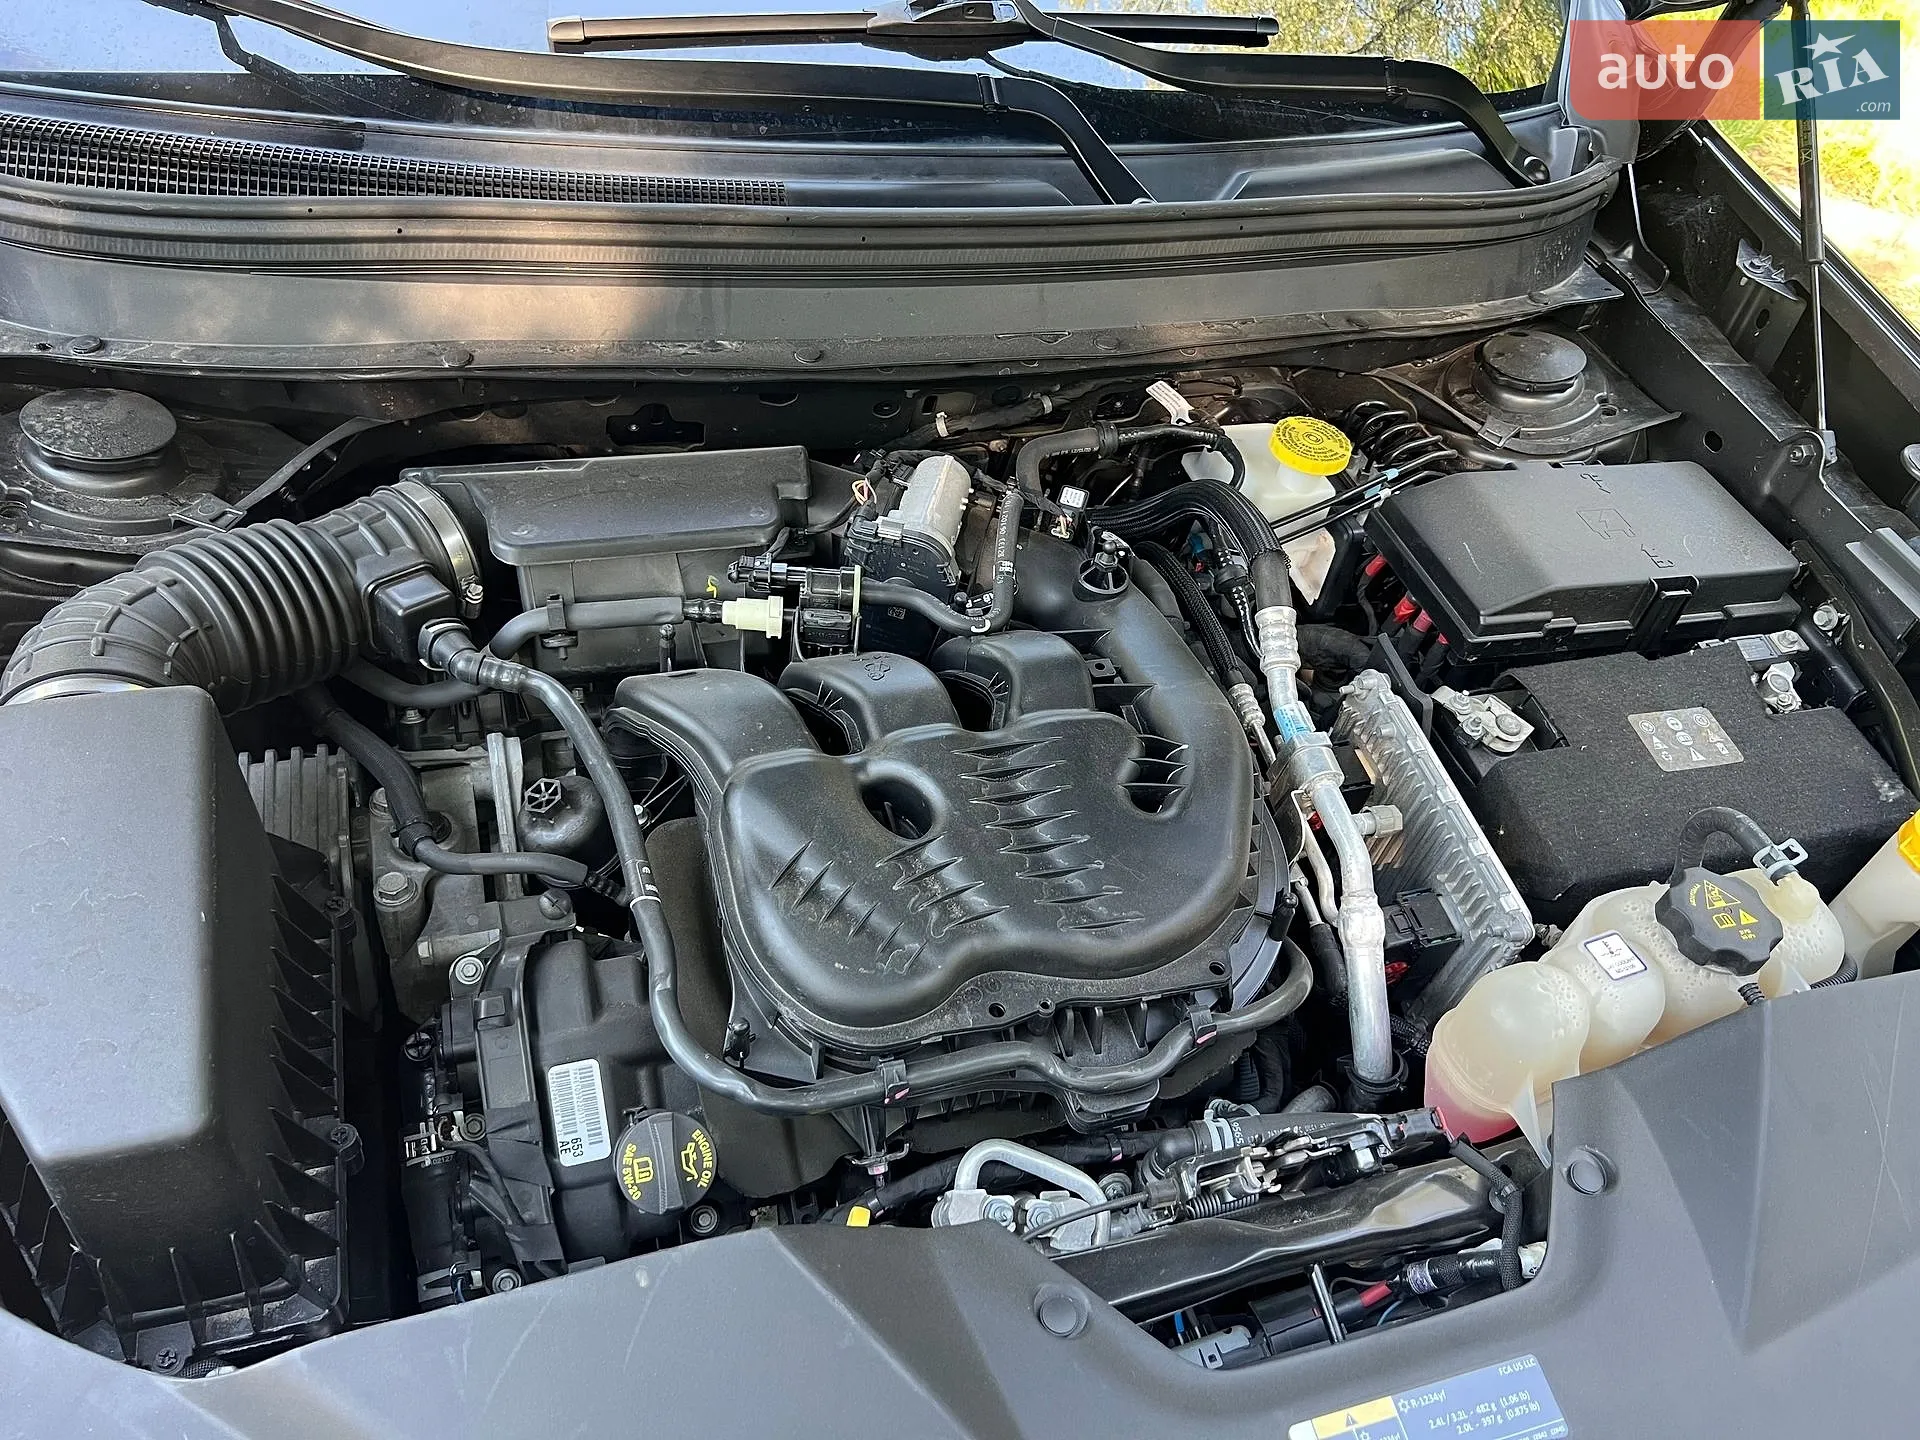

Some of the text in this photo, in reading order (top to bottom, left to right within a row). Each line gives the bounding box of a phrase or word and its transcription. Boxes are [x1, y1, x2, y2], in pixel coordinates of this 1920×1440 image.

[559, 1140, 571, 1155] AE
[571, 1137, 584, 1158] 653
[691, 1128, 713, 1188] ENGINE OIL
[622, 1143, 642, 1201] SAE 5W-20
[1498, 1358, 1536, 1376] FCA US LLC
[1411, 1388, 1447, 1409] R-1234yf
[1428, 1417, 1446, 1430] 2.4L
[1451, 1409, 1469, 1423] 3.2L
[1476, 1402, 1491, 1414] 482
[1456, 1421, 1474, 1435] 2.0L
[1481, 1415, 1496, 1427] 397
